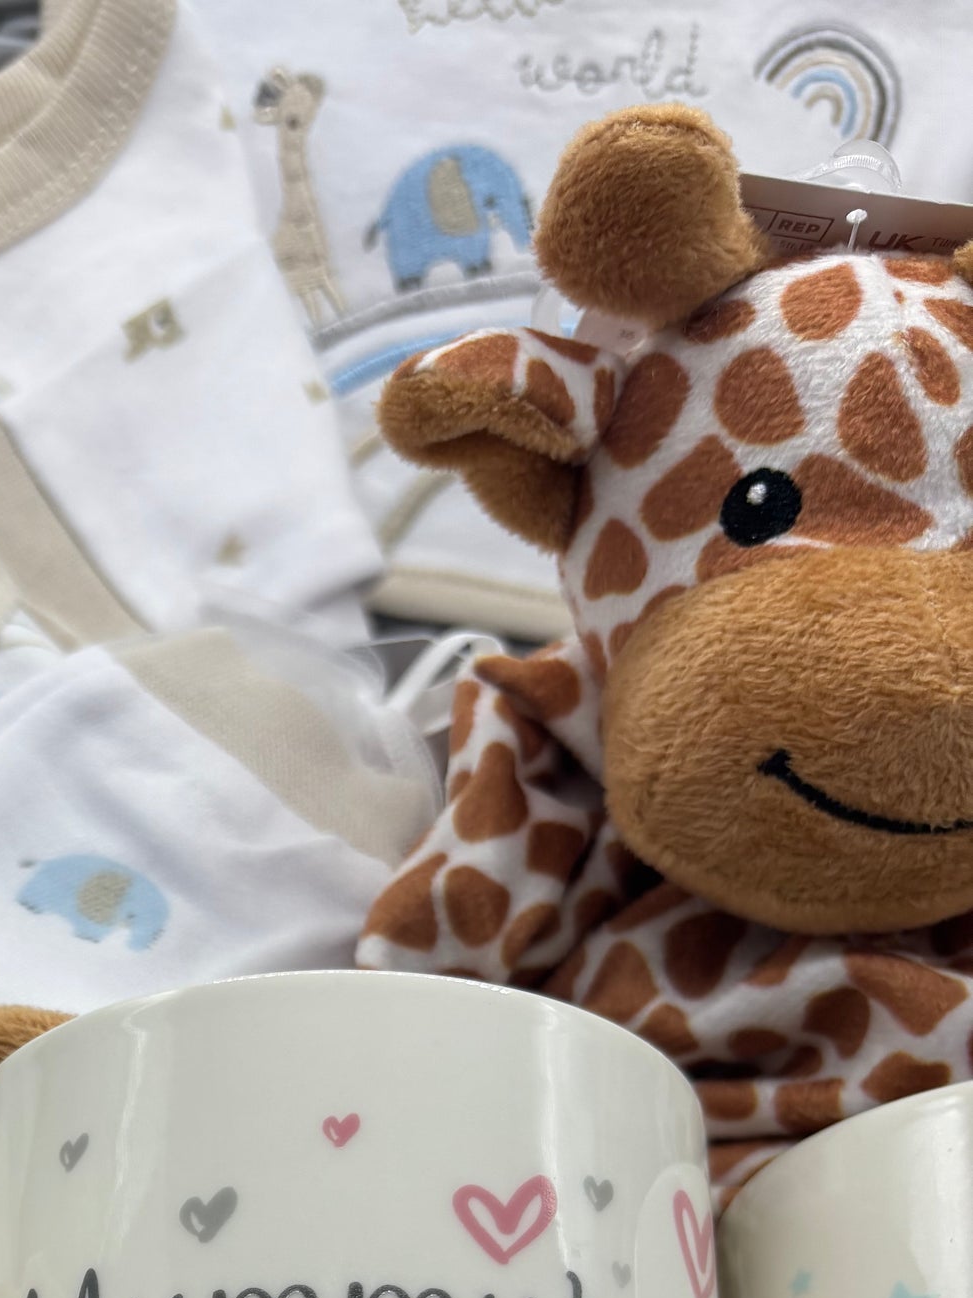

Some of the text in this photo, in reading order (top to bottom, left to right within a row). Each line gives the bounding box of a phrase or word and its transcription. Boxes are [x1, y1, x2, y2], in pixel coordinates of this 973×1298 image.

[514, 22, 709, 99] world
[777, 218, 821, 234] REP
[868, 230, 926, 251] UK
